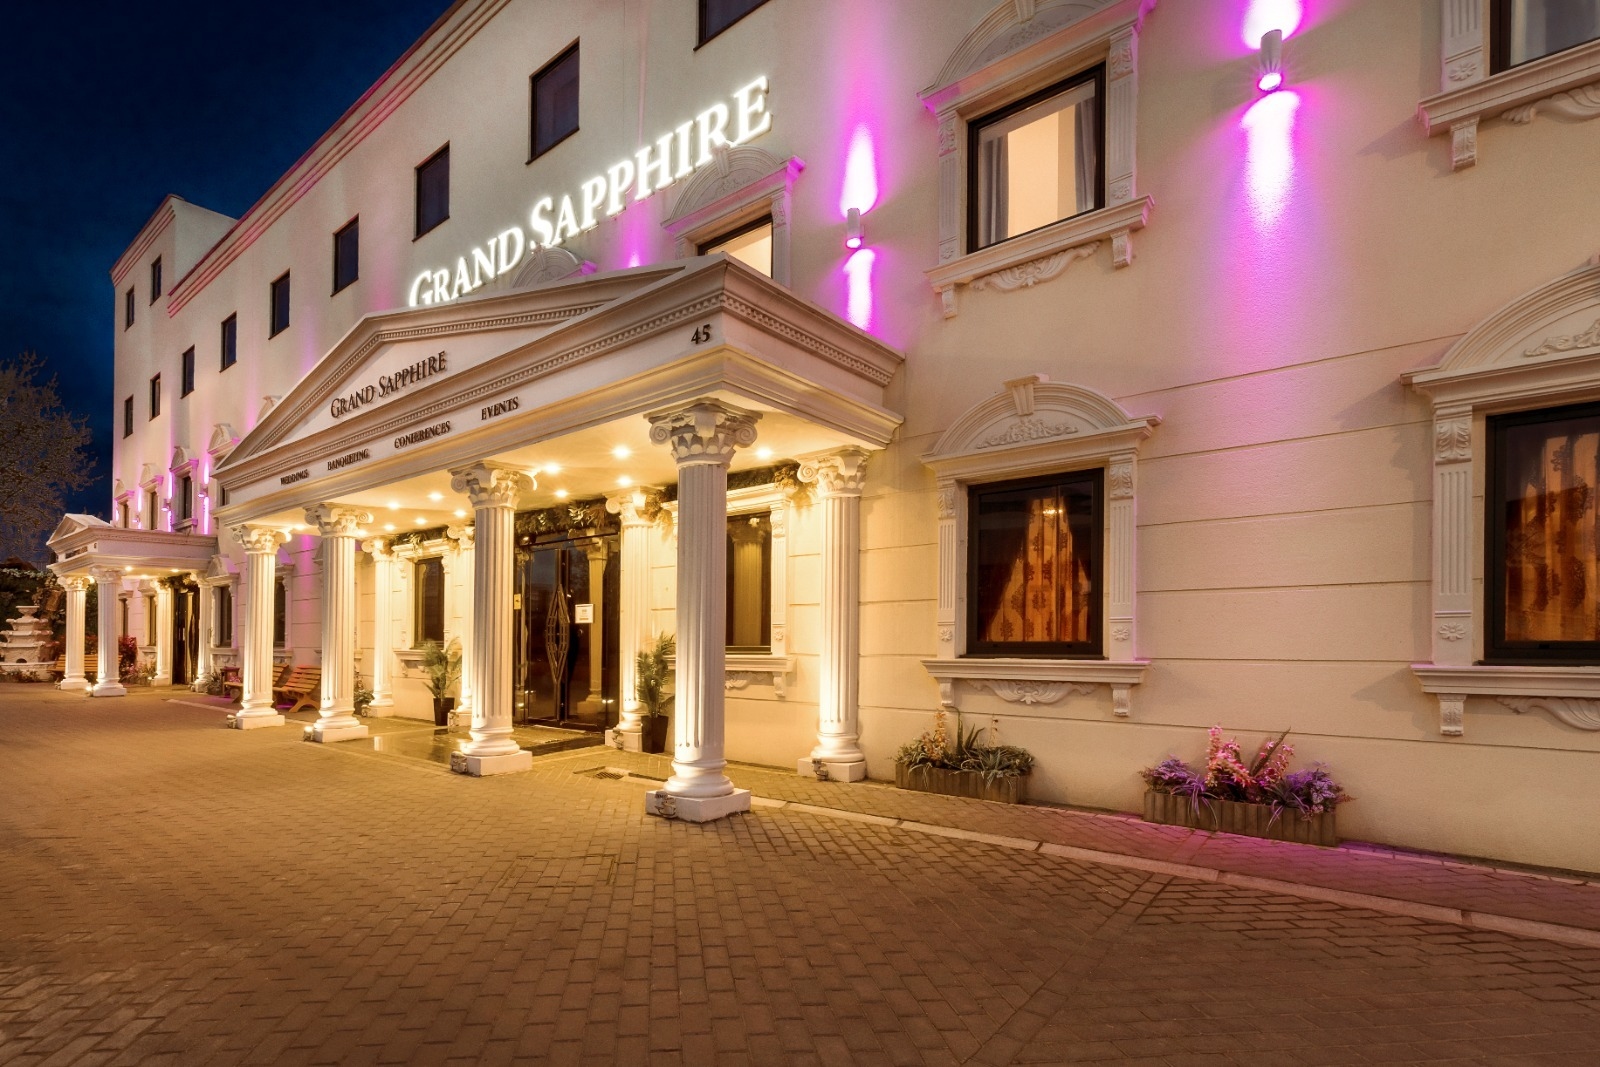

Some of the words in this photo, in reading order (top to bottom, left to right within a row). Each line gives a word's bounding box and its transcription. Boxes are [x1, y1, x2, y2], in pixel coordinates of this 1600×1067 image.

[408, 227, 524, 307] GRAND
[530, 76, 772, 250] SAPPHIRE
[691, 324, 710, 345] 45
[330, 385, 375, 418] GRAND
[378, 350, 447, 398] SAPPHIRE
[327, 448, 369, 471] BANQUETING
[394, 420, 451, 449] CONFERENCES
[481, 396, 519, 420] EVENTS
